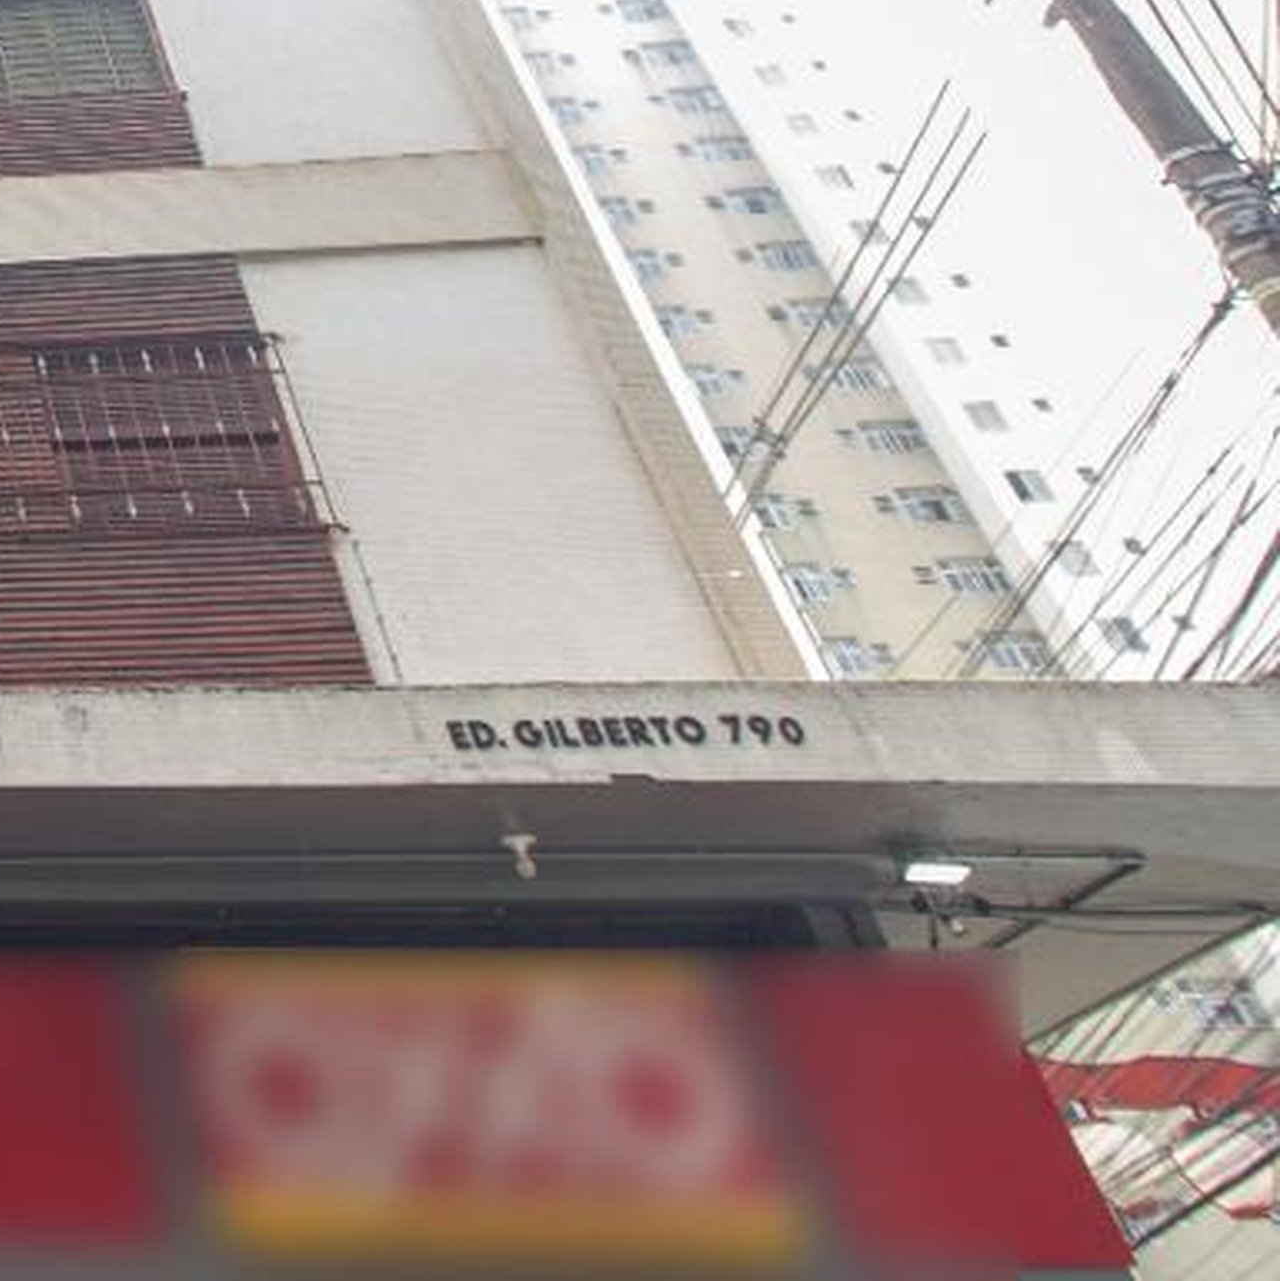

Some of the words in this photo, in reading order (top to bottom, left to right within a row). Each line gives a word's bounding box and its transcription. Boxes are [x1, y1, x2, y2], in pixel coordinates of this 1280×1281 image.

[446, 720, 509, 751] ED.
[513, 716, 707, 750] GILBERTO
[718, 715, 805, 746] 790
